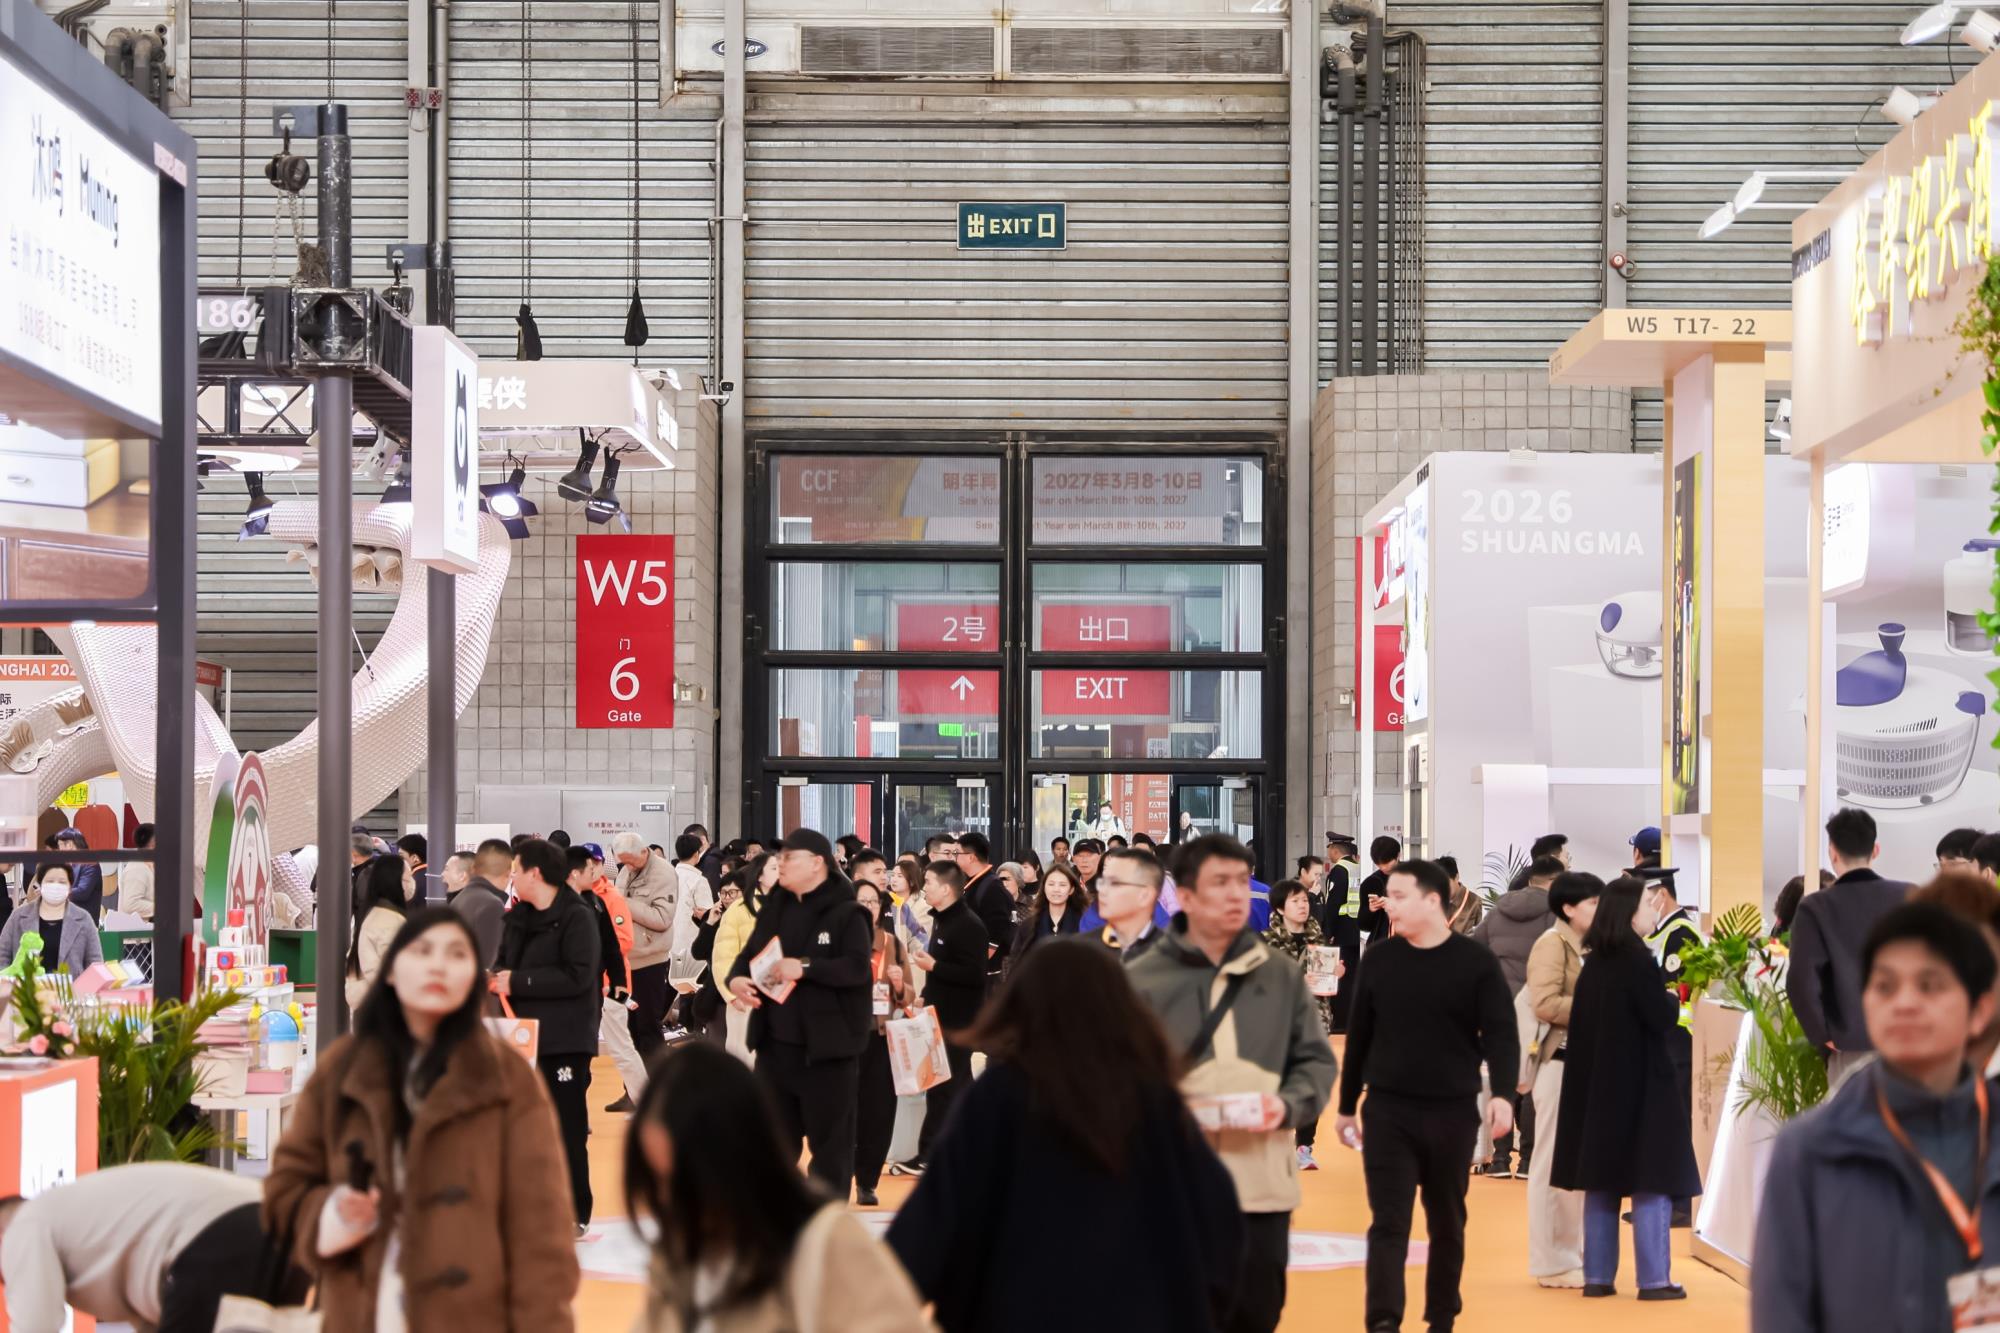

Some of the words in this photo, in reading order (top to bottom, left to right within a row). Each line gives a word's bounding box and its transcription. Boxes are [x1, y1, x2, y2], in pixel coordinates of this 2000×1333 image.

[967, 213, 985, 238] 出
[989, 218, 1033, 235] EXIT
[1037, 213, 1056, 239] 口
[1627, 316, 1658, 333] W5
[1674, 317, 1719, 335] T17-
[1732, 318, 1756, 335] 22
[801, 469, 839, 492] CCF
[1460, 488, 1574, 524] 2026
[1460, 529, 1645, 556] SHUANGMA
[583, 559, 667, 607] W5
[942, 616, 987, 643] 2号
[1079, 615, 1129, 642] 出口
[50, 663, 77, 677] 202
[609, 656, 641, 702] 6
[1075, 676, 1129, 699] EXIT
[607, 709, 642, 722] Gate
